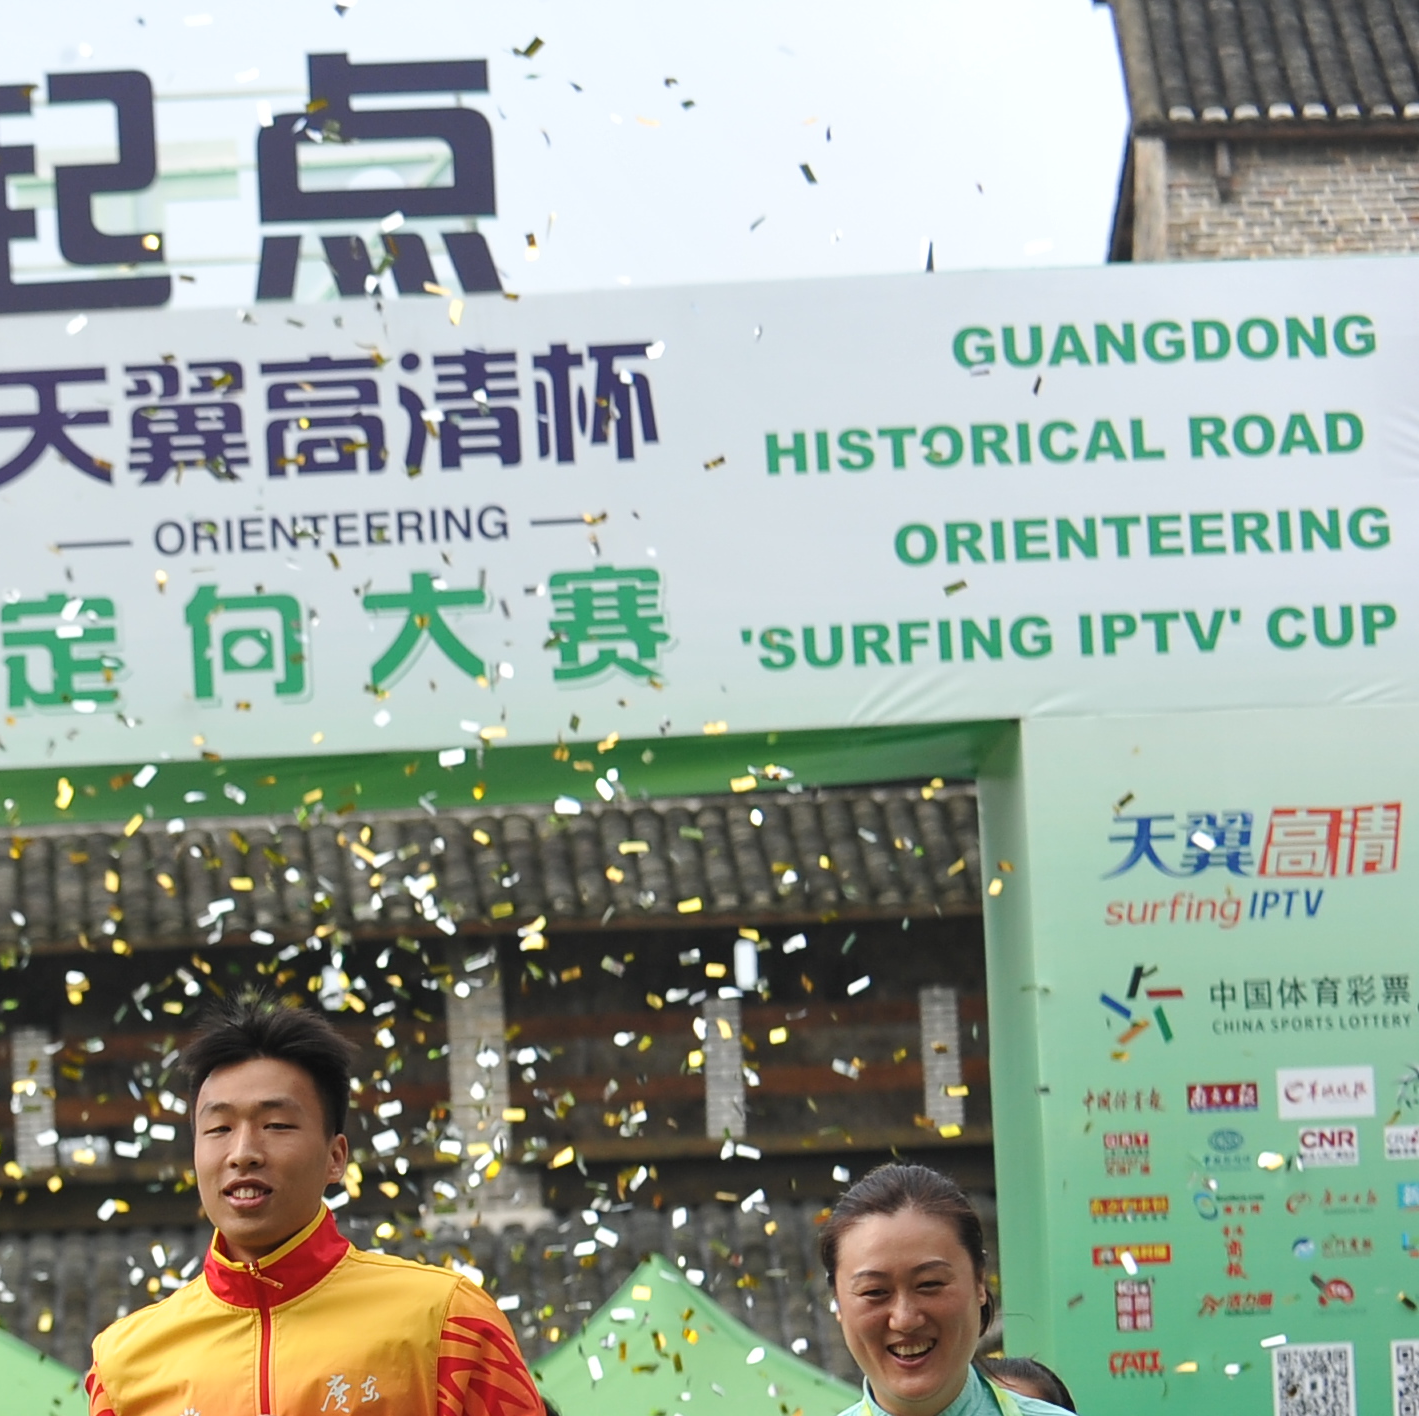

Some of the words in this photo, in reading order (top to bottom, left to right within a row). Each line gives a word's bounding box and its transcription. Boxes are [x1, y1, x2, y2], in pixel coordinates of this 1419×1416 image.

[951, 311, 1379, 371] GUANGDONG
[764, 418, 1164, 476] HISTORICAL
[1188, 409, 1367, 461] ROAD
[151, 503, 511, 559] ORIENTEERING
[894, 506, 1392, 569] ORIENTEERING
[738, 612, 1054, 672] 'SURFING
[1265, 602, 1399, 650] CUP
[1105, 891, 1242, 930] surfing
[1249, 888, 1324, 920] IPTV
[1210, 974, 1411, 1011] 中国体育彩票
[1213, 1018, 1264, 1035] CHINA
[1270, 1016, 1334, 1034] SPORTS
[1340, 1013, 1411, 1031] LOTTERY
[1300, 1130, 1355, 1149] CNR
